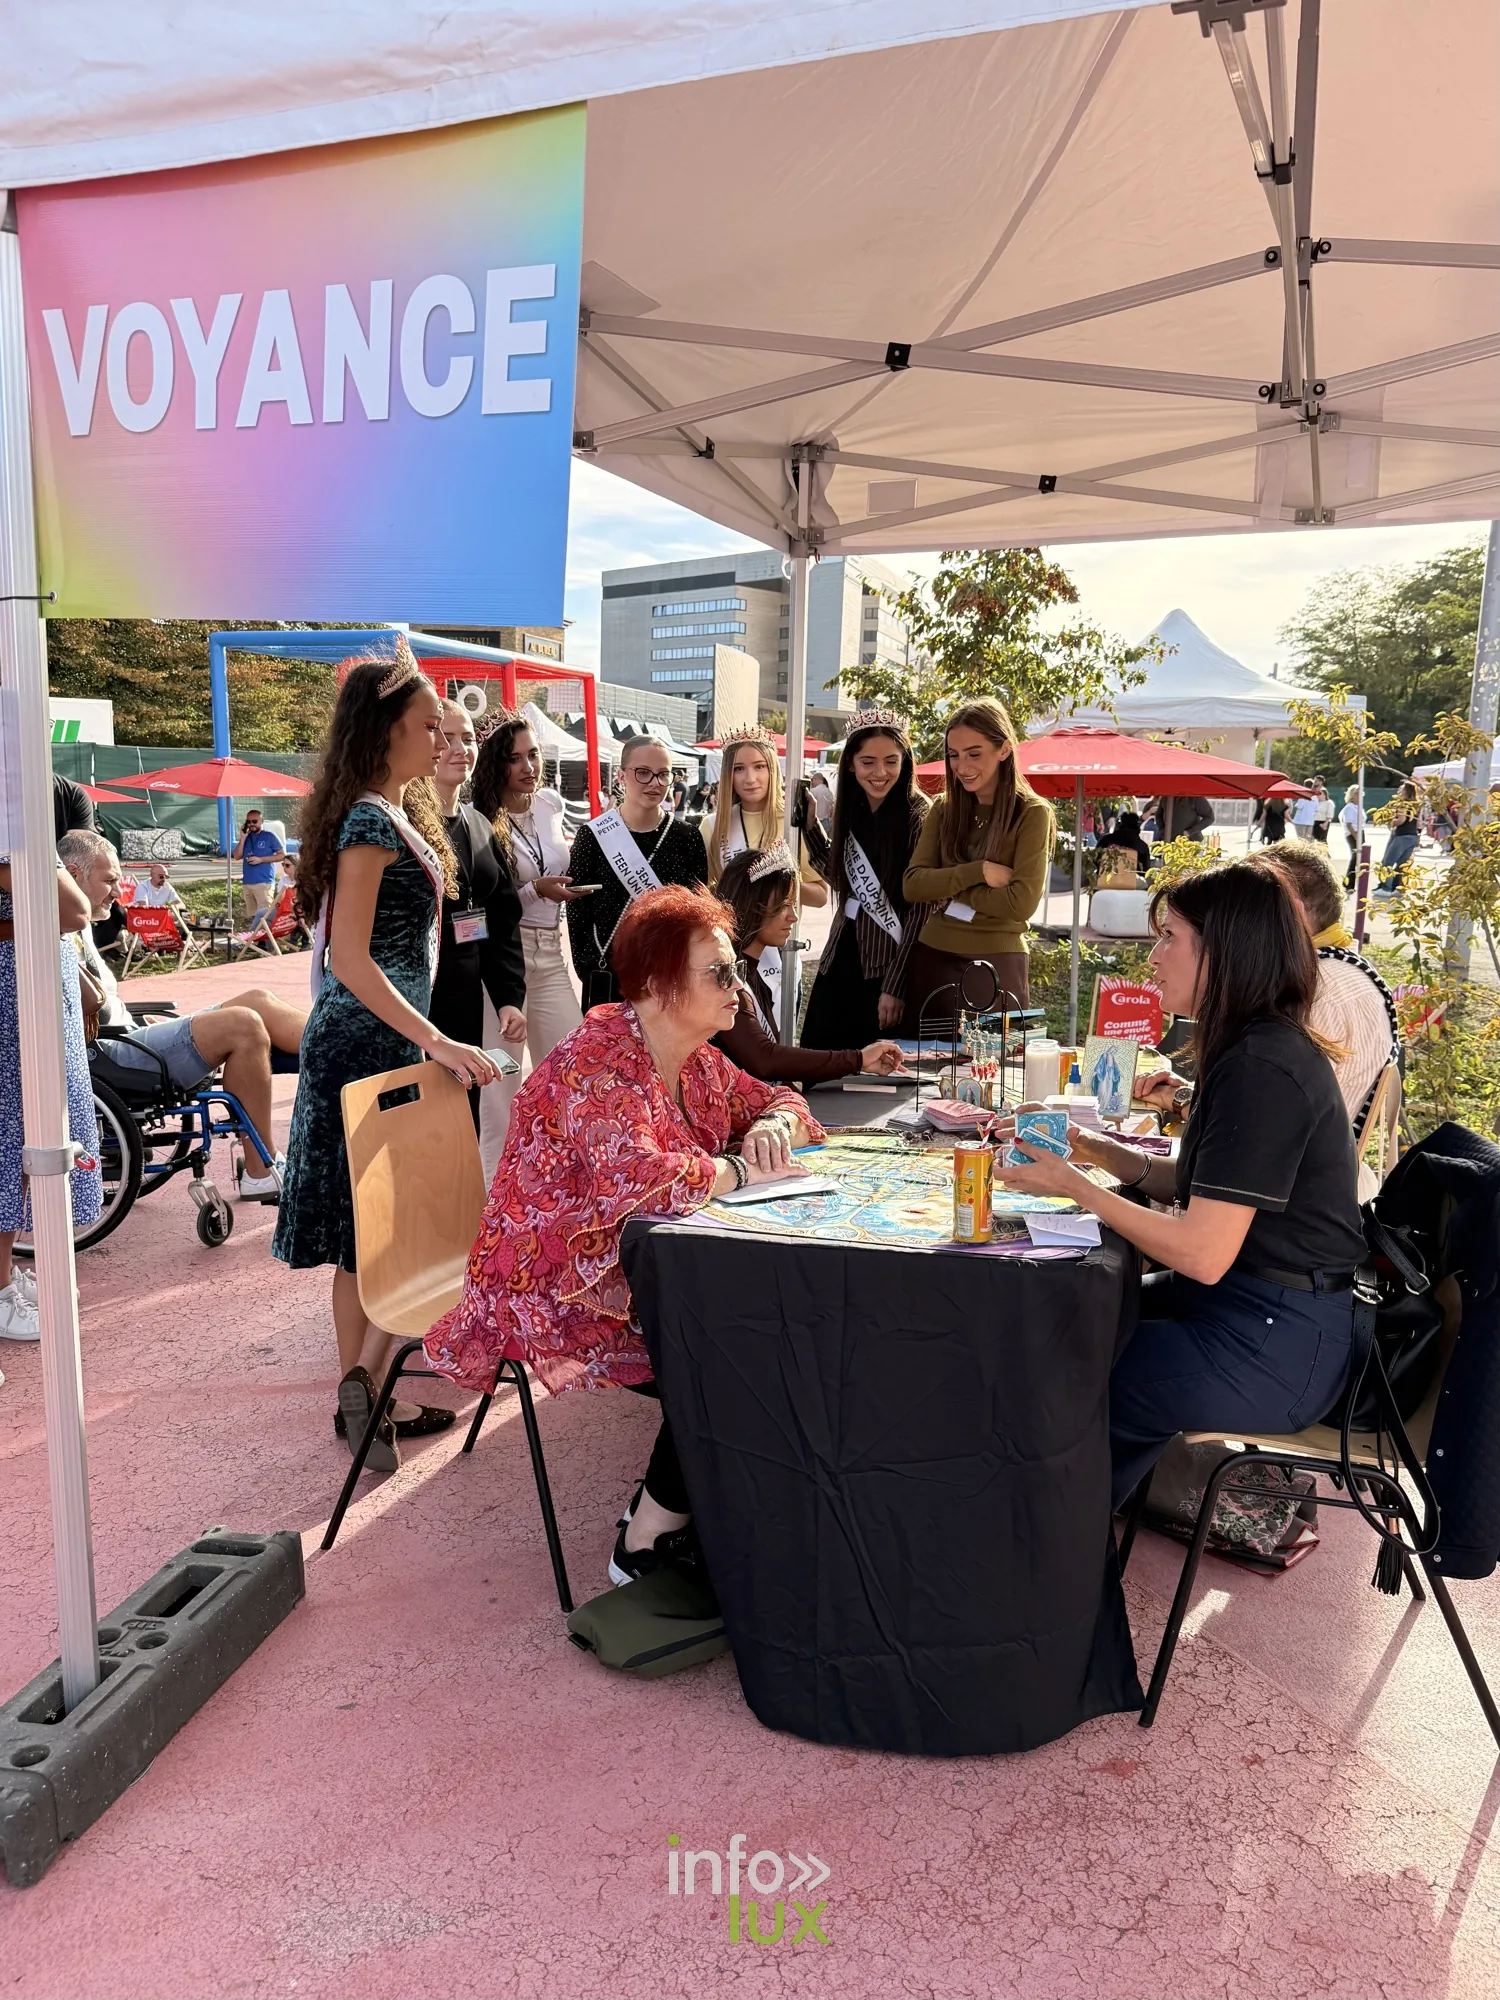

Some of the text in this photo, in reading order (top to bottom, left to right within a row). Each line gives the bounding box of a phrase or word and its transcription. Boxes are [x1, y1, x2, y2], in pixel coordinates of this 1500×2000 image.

[42, 263, 556, 437] VOYANCE
[1028, 763, 1117, 772] Carola
[596, 816, 614, 828] MISS
[597, 821, 621, 835] PETITE
[612, 852, 644, 895] TEEN UNI
[855, 885, 875, 914] LOR
[857, 863, 897, 931] DAUPHINE
[133, 916, 159, 928] Carola
[1111, 992, 1150, 1006] Carola
[1104, 1019, 1150, 1029] Comme
[1124, 1026, 1151, 1034] envie
